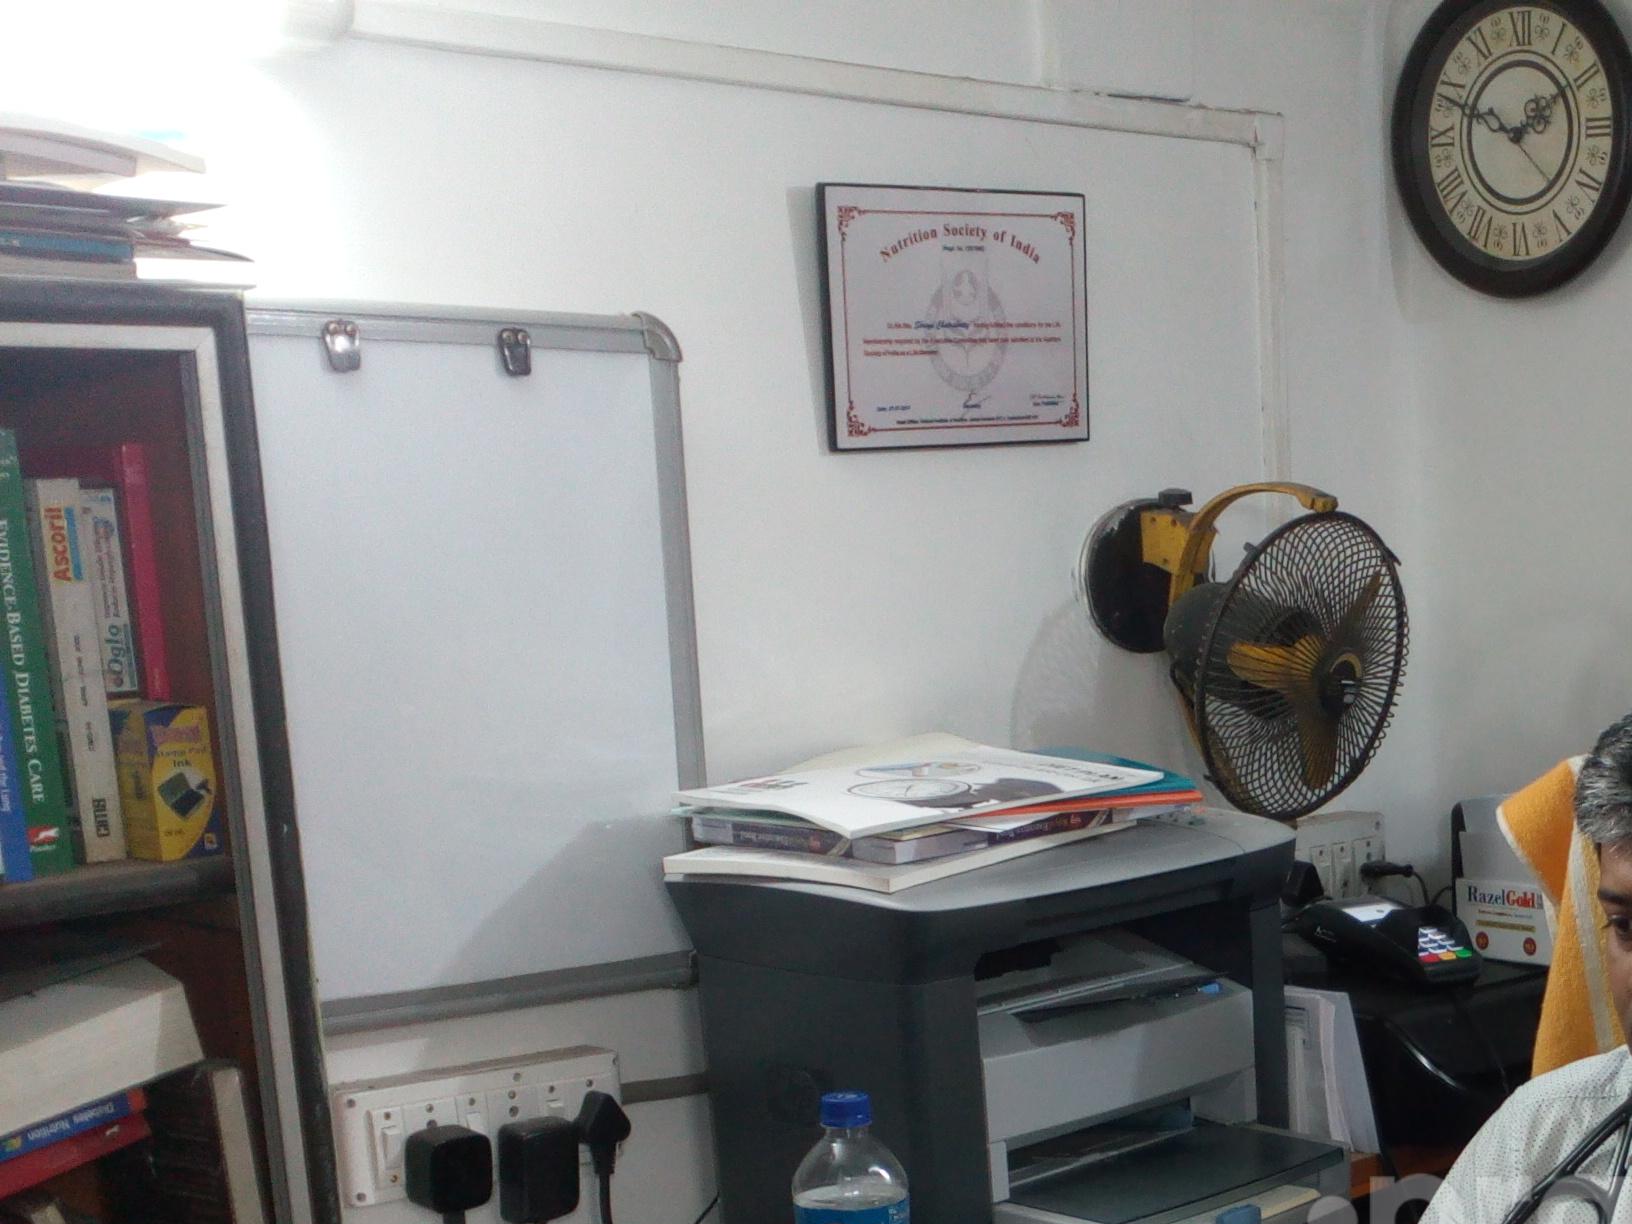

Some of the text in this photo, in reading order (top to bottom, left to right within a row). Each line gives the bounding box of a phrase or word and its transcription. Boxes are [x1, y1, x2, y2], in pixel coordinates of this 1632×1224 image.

[879, 223, 1040, 264] Nutrition Society of India
[44, 507, 72, 582] Ascoril
[15, 671, 37, 754] DIABETES
[28, 759, 45, 803] CARE
